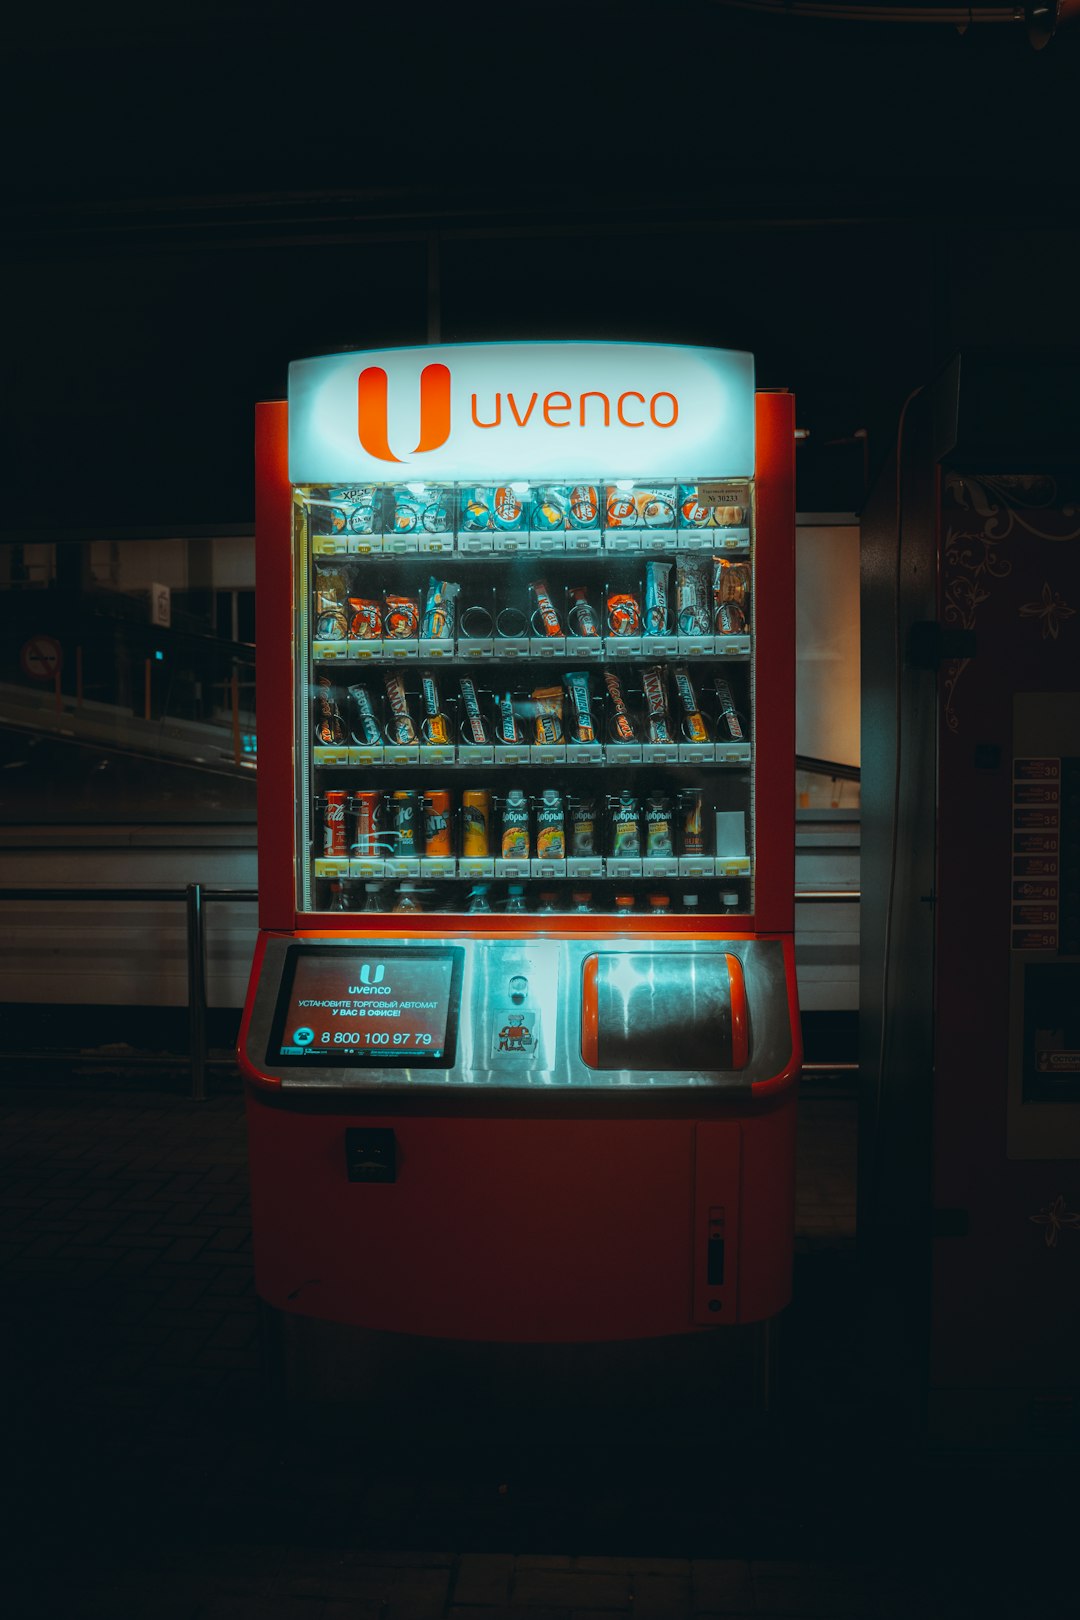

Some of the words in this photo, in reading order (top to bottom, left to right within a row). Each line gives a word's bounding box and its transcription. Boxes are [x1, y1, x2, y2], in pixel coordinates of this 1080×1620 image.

[470, 391, 679, 428] uvenco
[643, 674, 664, 712] TWIX
[574, 686, 591, 728] SNICKRS
[348, 986, 392, 995] uvenco
[298, 1000, 351, 1008] УСТАНОВИТЕ
[353, 1000, 398, 1008] ТОРГОВЫЙ
[399, 1001, 439, 1009] АВТОМАТ
[367, 1009, 401, 1017] ОФИСЕ!
[321, 1031, 330, 1044] 8
[333, 1032, 360, 1044] 800
[364, 1032, 390, 1044] 100
[393, 1033, 411, 1045] 97
[415, 1033, 432, 1045] 79
